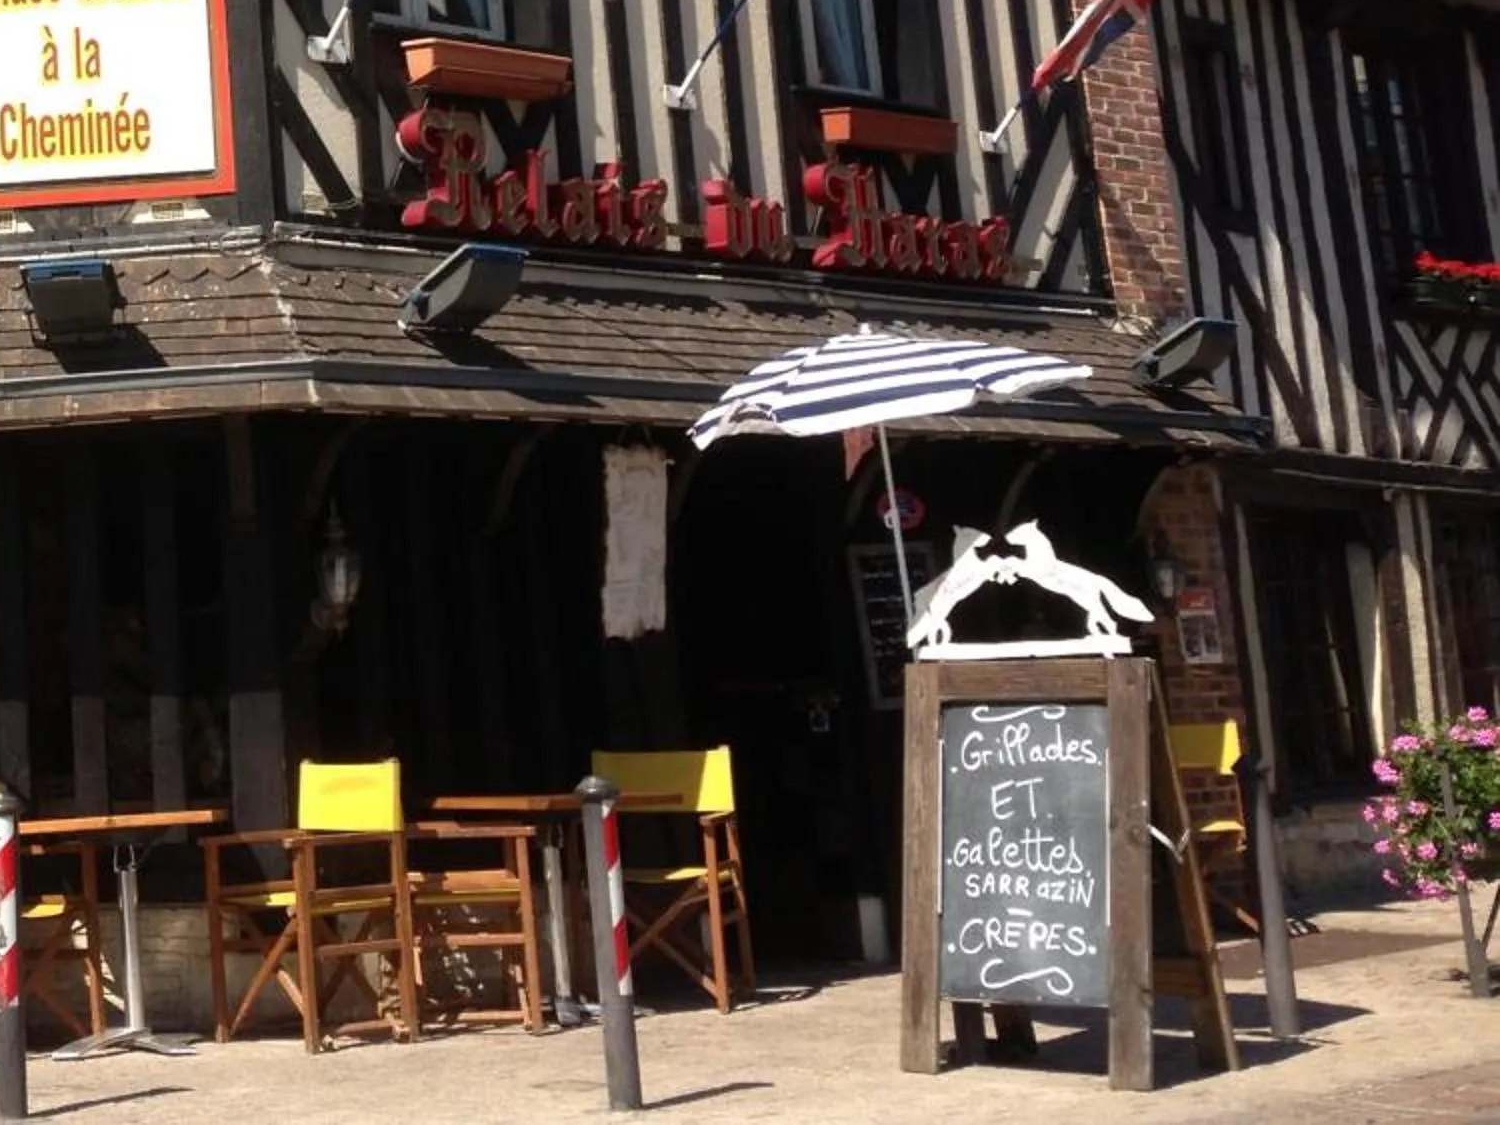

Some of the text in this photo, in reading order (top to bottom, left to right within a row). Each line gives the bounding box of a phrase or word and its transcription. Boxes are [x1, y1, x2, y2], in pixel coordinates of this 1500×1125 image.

[41, 25, 101, 81] à la
[396, 108, 669, 248] Relais
[803, 162, 1012, 280] Haras
